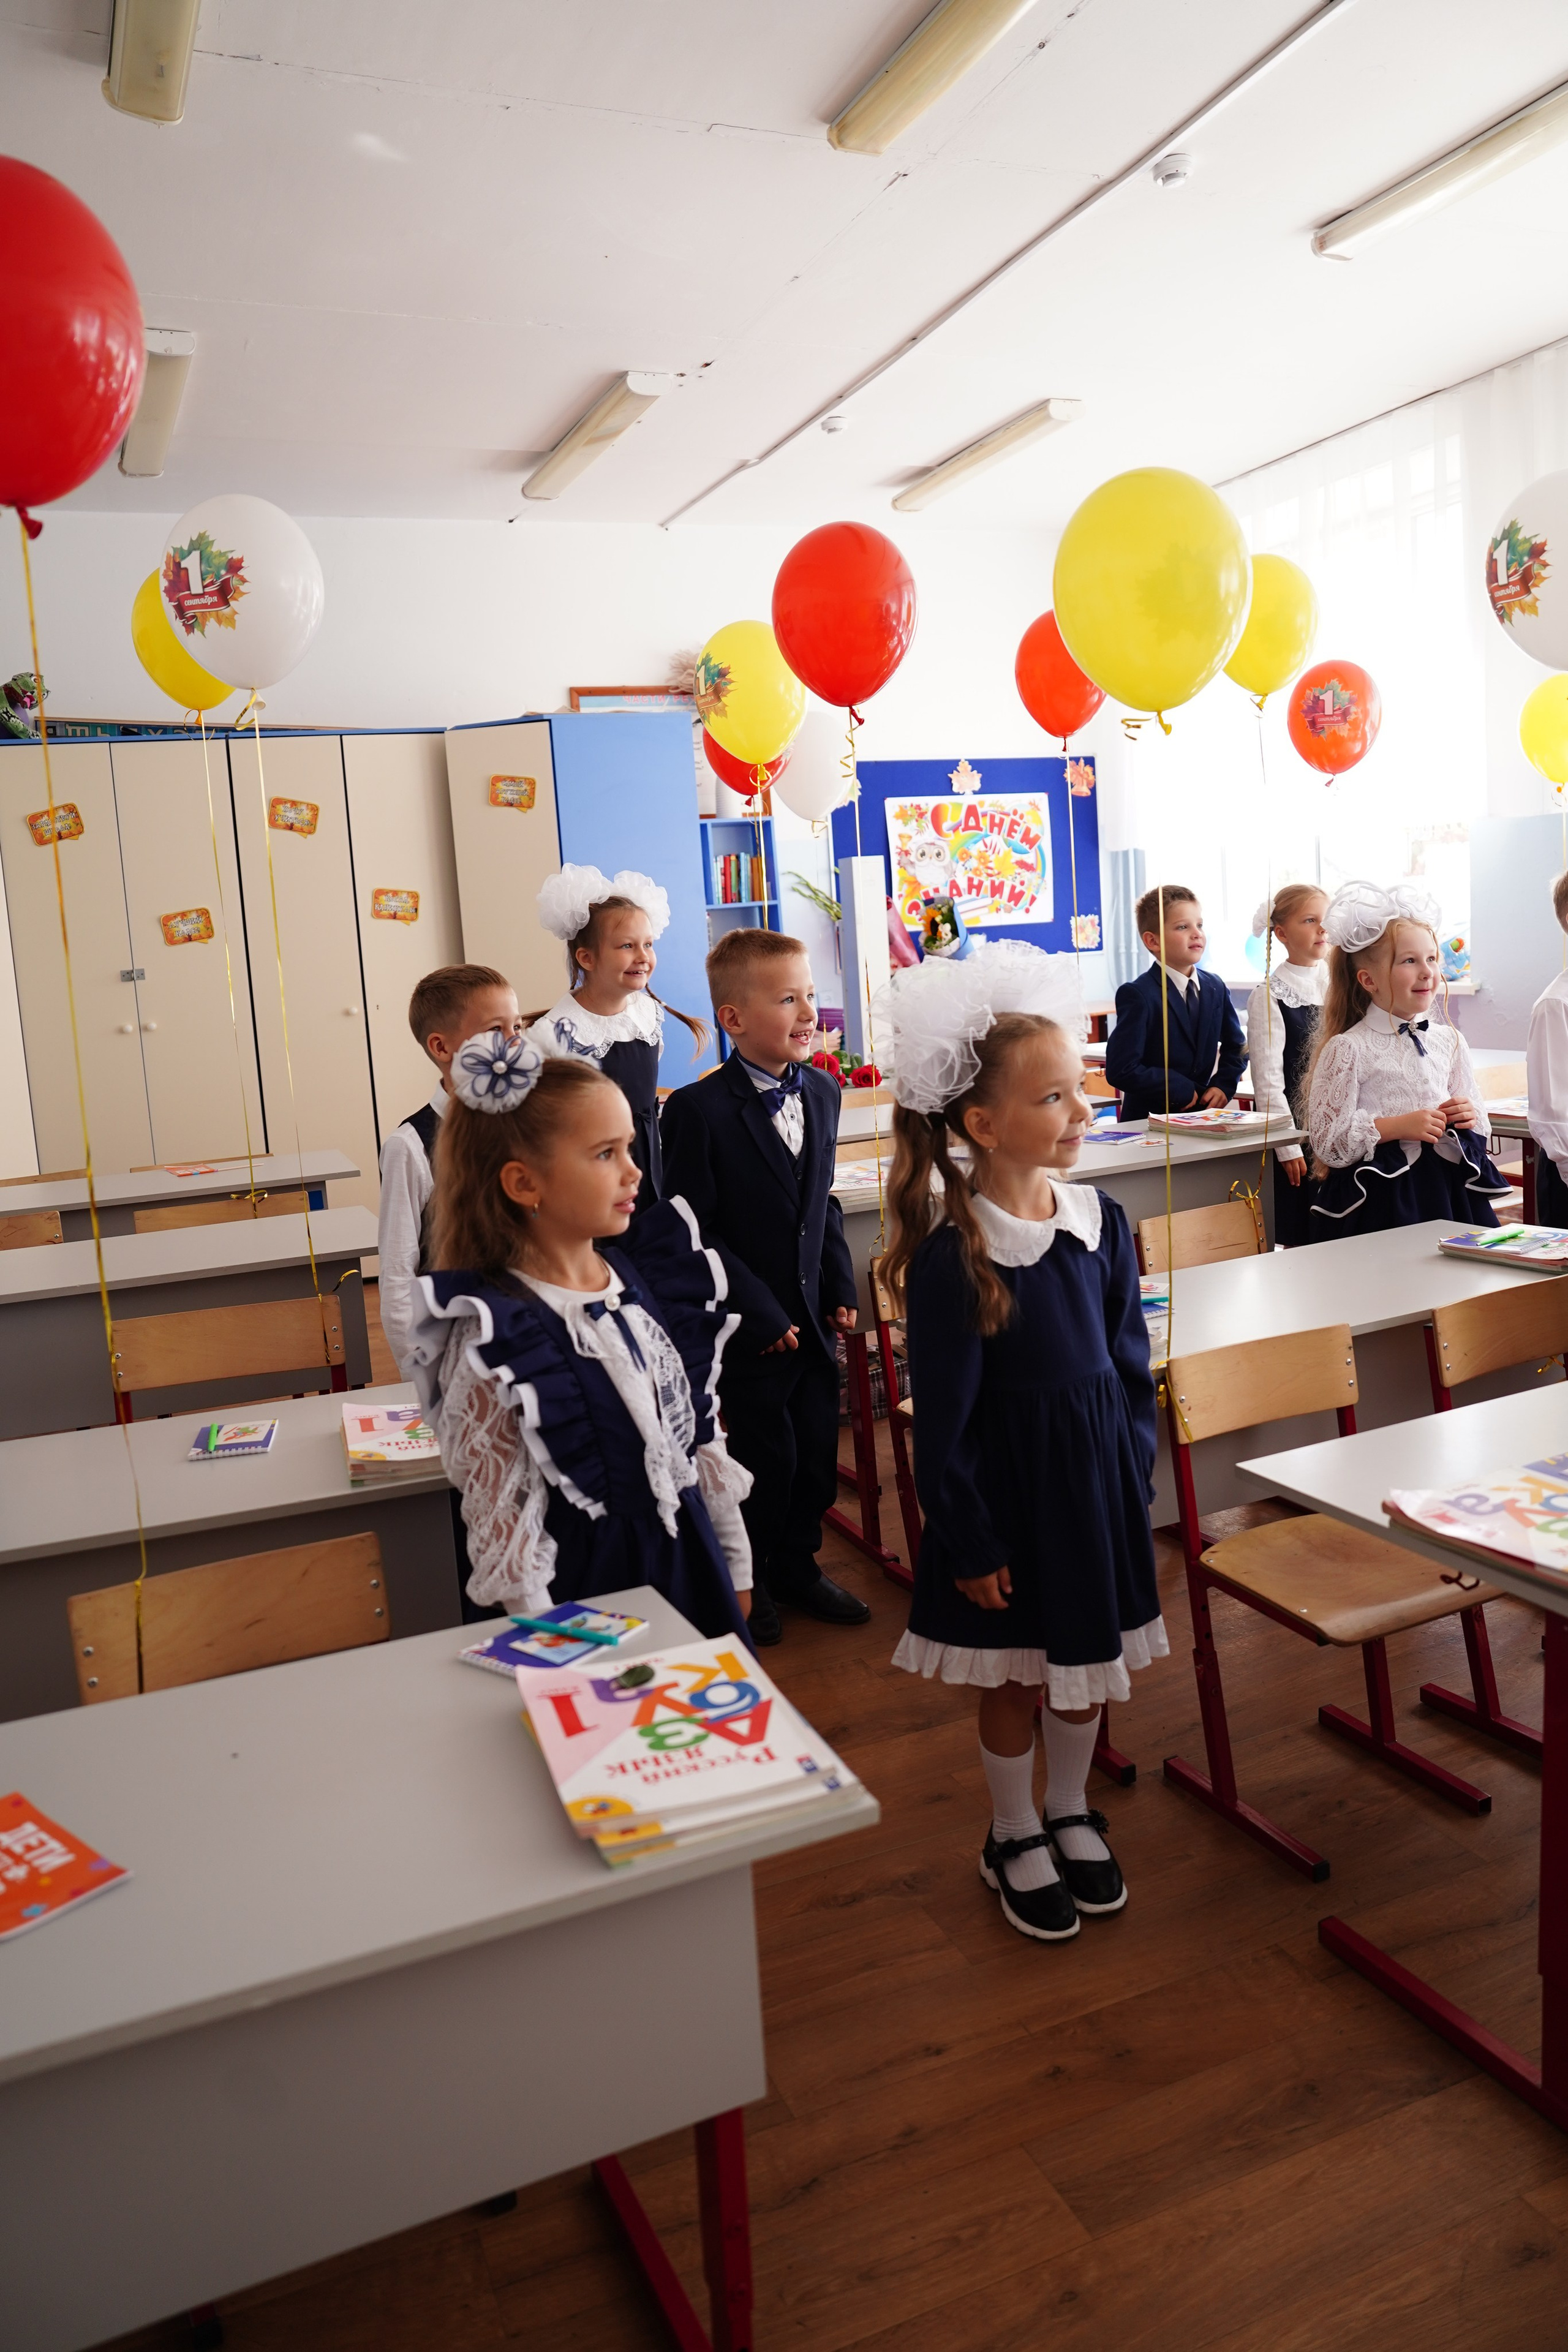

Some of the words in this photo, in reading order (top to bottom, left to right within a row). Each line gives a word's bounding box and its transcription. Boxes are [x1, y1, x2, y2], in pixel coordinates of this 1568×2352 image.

[181, 549, 204, 595] 1
[1493, 538, 1509, 586] 1
[185, 595, 217, 606] сентября
[622, 695, 666, 703] ЧАСТИ
[696, 665, 706, 696] 1
[1319, 690, 1334, 715] 1
[931, 803, 953, 839] С
[962, 804, 1041, 850] ДНЁМ
[538, 1691, 599, 1739] 1
